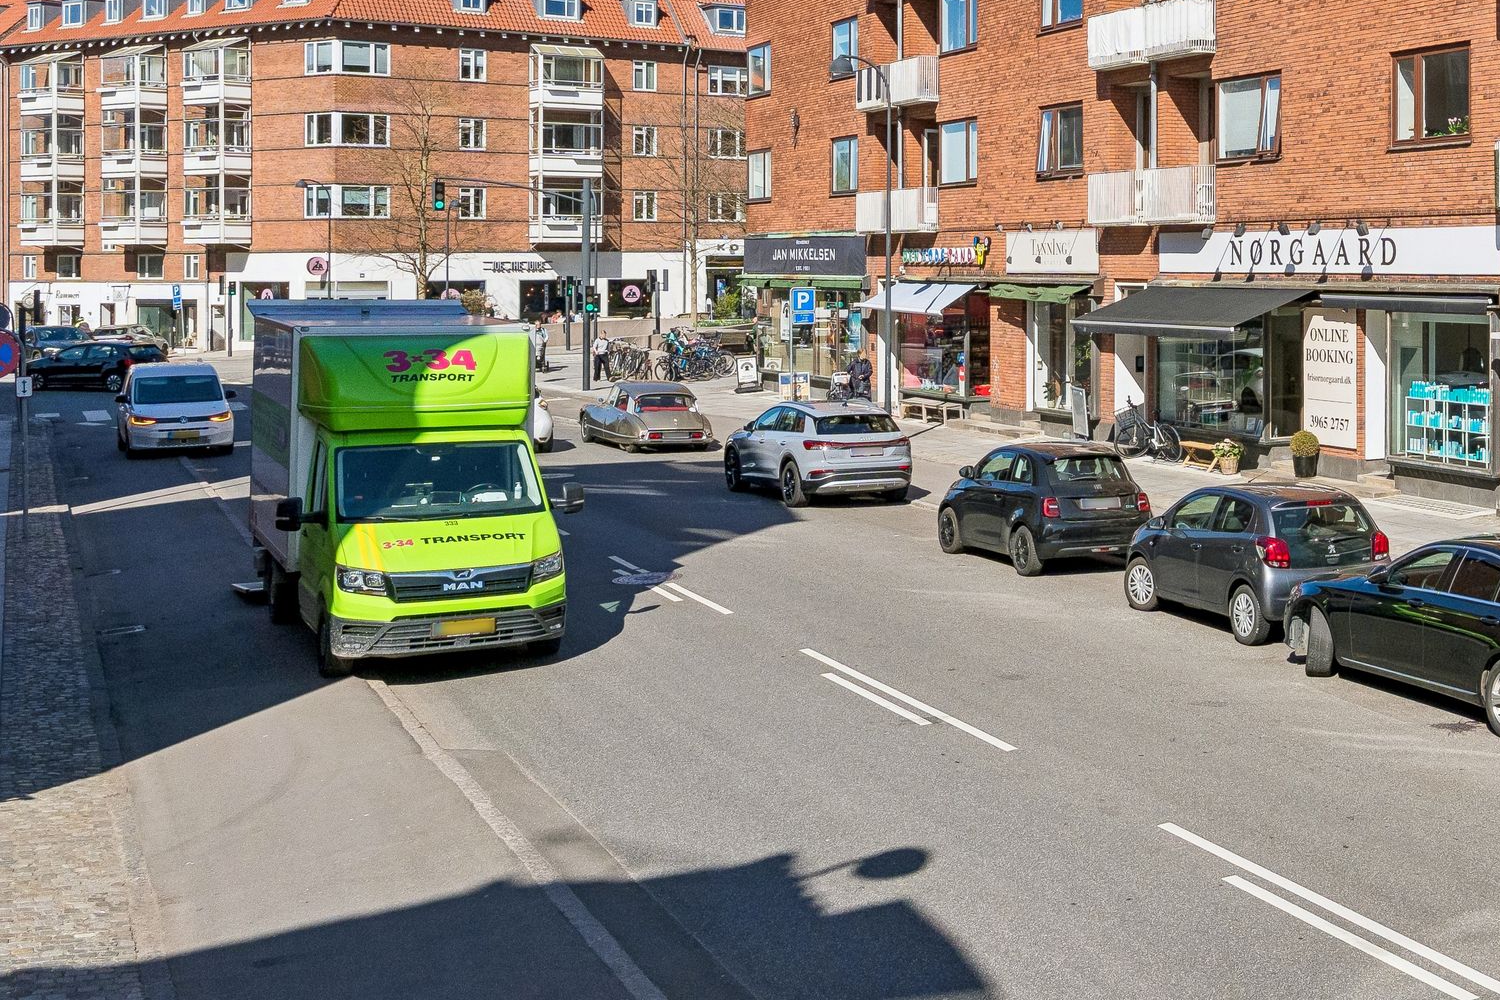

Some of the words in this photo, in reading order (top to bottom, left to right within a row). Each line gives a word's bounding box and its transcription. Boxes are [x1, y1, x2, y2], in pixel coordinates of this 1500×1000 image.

[1031, 238, 1067, 255] TANNING
[1230, 238, 1397, 266] NØRGAARD
[772, 248, 788, 261] JAN
[789, 248, 836, 261] MIKKELSEN
[797, 292, 810, 309] P
[1310, 328, 1349, 343] ONLINE
[1306, 348, 1353, 364] BOOKING
[391, 373, 475, 383] TRANSPORT
[1310, 415, 1329, 430] 3965
[1330, 417, 1350, 432] 2757
[420, 532, 526, 545] TRANSPORT
[443, 580, 483, 592] MAN
